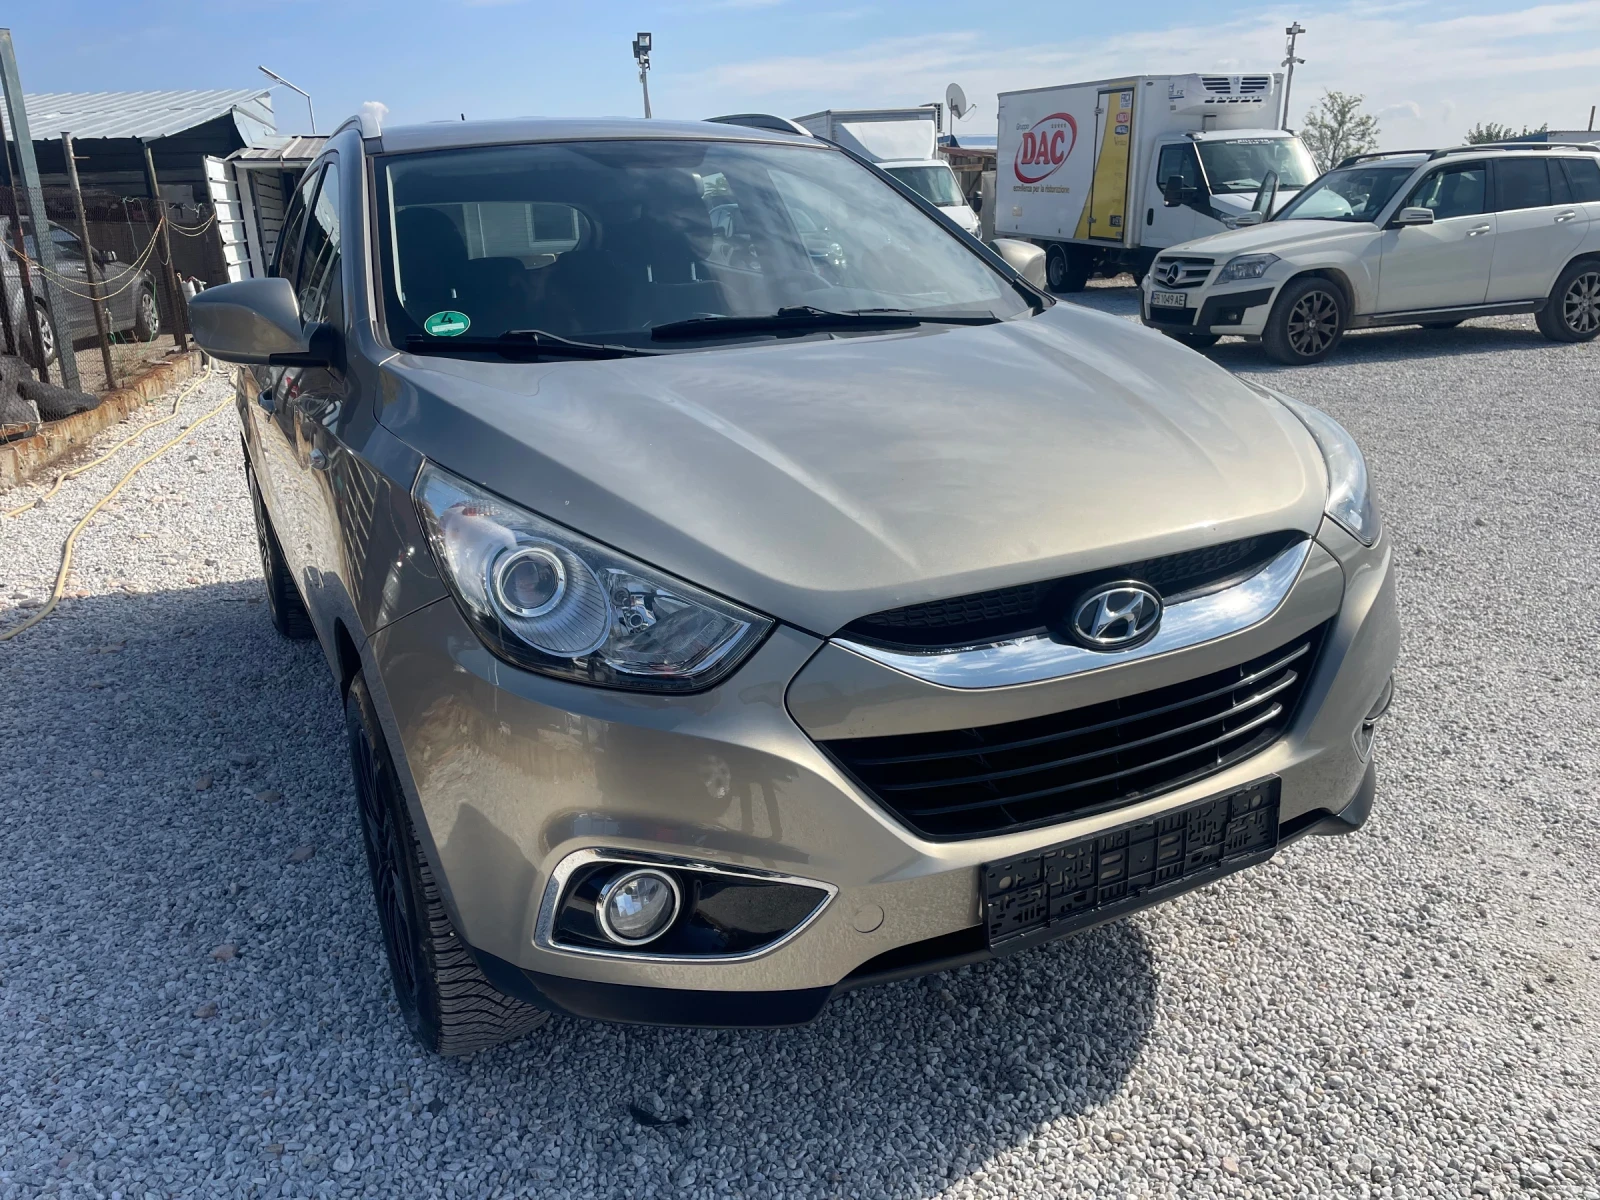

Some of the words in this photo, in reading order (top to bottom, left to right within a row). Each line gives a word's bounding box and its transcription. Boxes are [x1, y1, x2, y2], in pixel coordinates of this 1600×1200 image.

[1021, 130, 1065, 165] DAC
[1161, 294, 1174, 305] 1049
[1174, 294, 1184, 306] AE
[441, 311, 454, 324] 4
